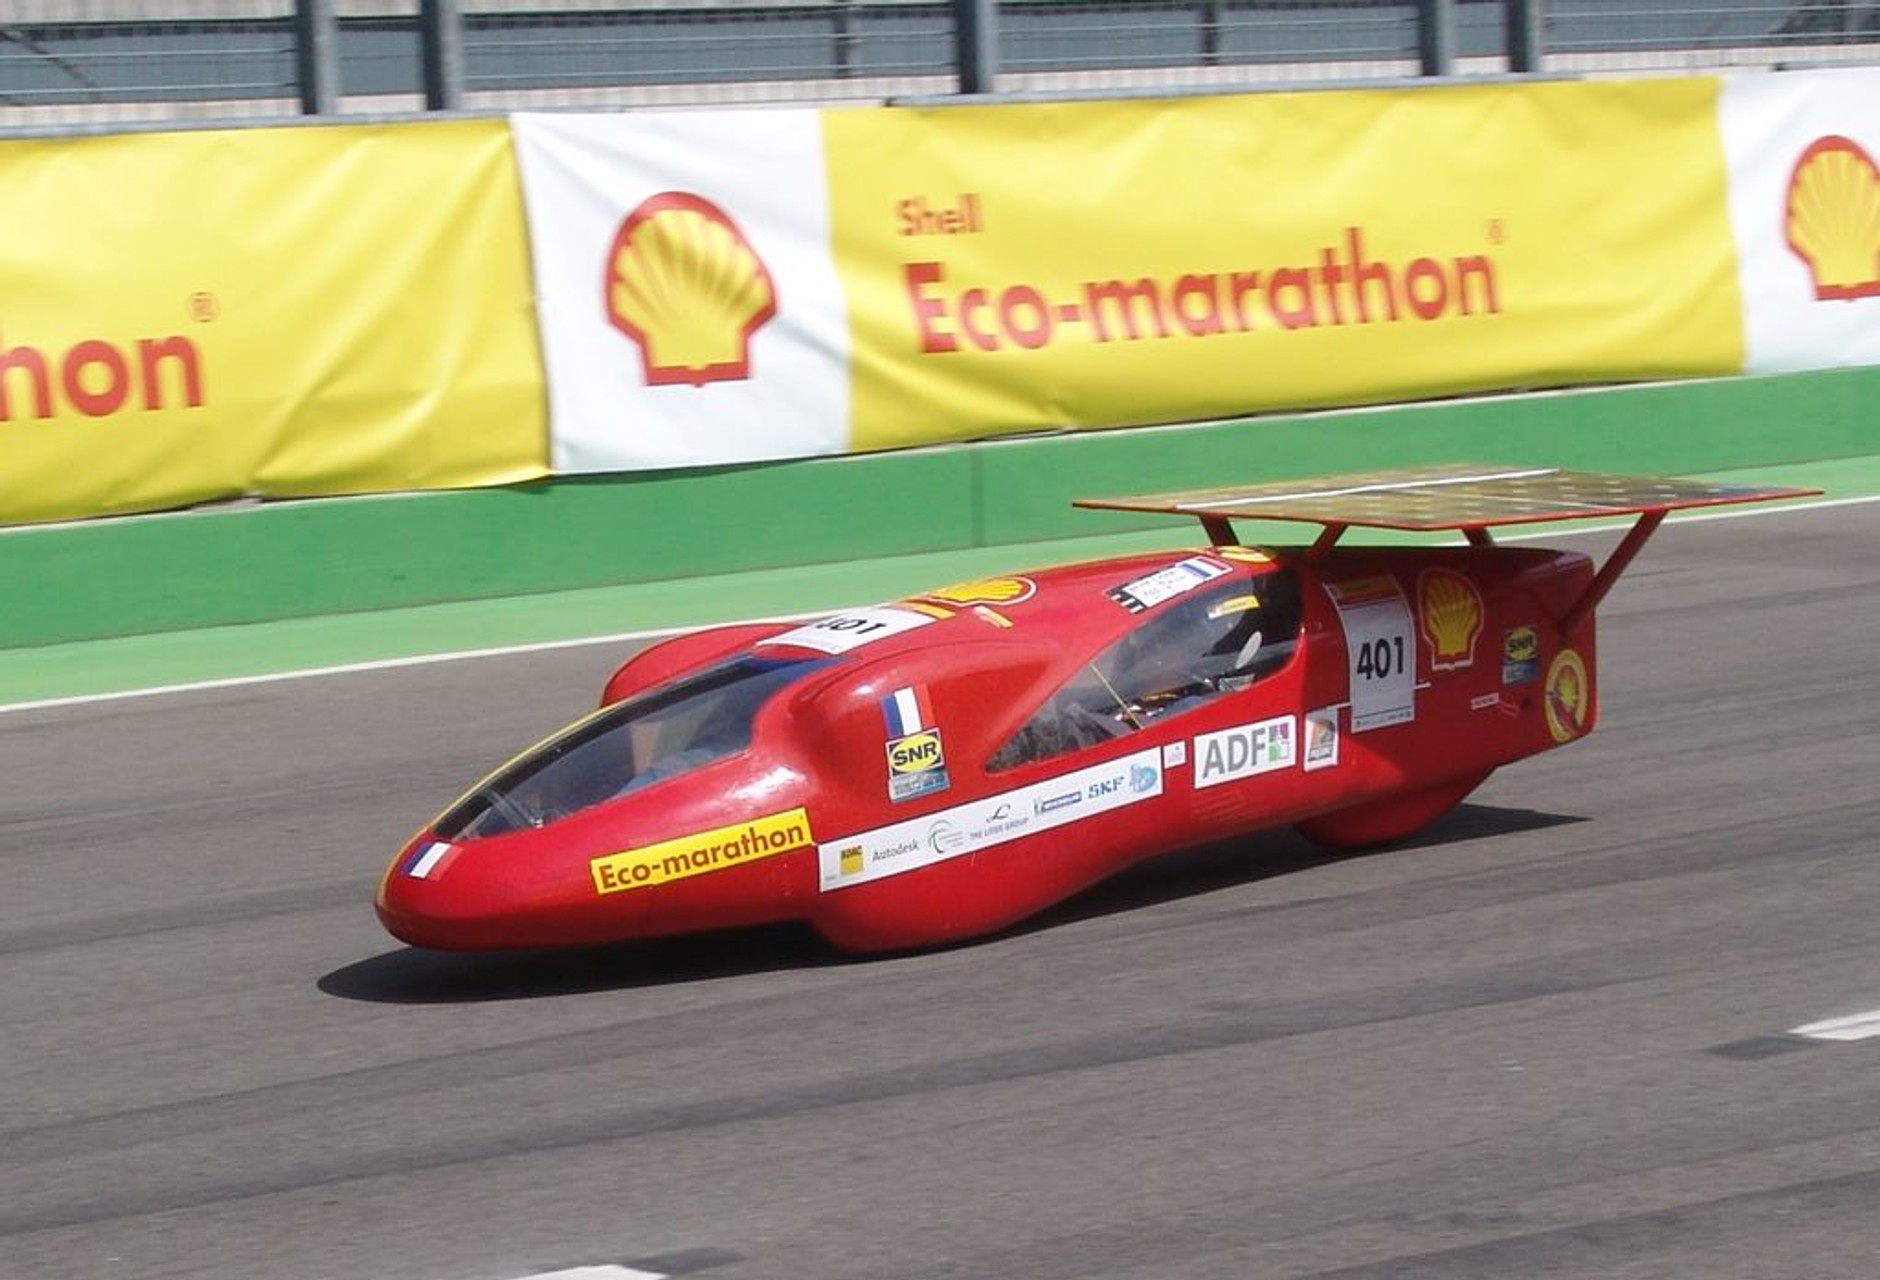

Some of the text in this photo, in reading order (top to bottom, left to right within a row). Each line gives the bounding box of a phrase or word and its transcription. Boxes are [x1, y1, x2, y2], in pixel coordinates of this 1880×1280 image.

[898, 193, 982, 235] Shell
[904, 227, 1500, 353] Eco-marathon
[1357, 636, 1404, 680] 401
[893, 741, 937, 767] SNR
[1202, 727, 1266, 778] ADF
[1088, 776, 1125, 798] SKF
[599, 825, 804, 889] Eco-marathon
[872, 838, 920, 862] Autodesk
